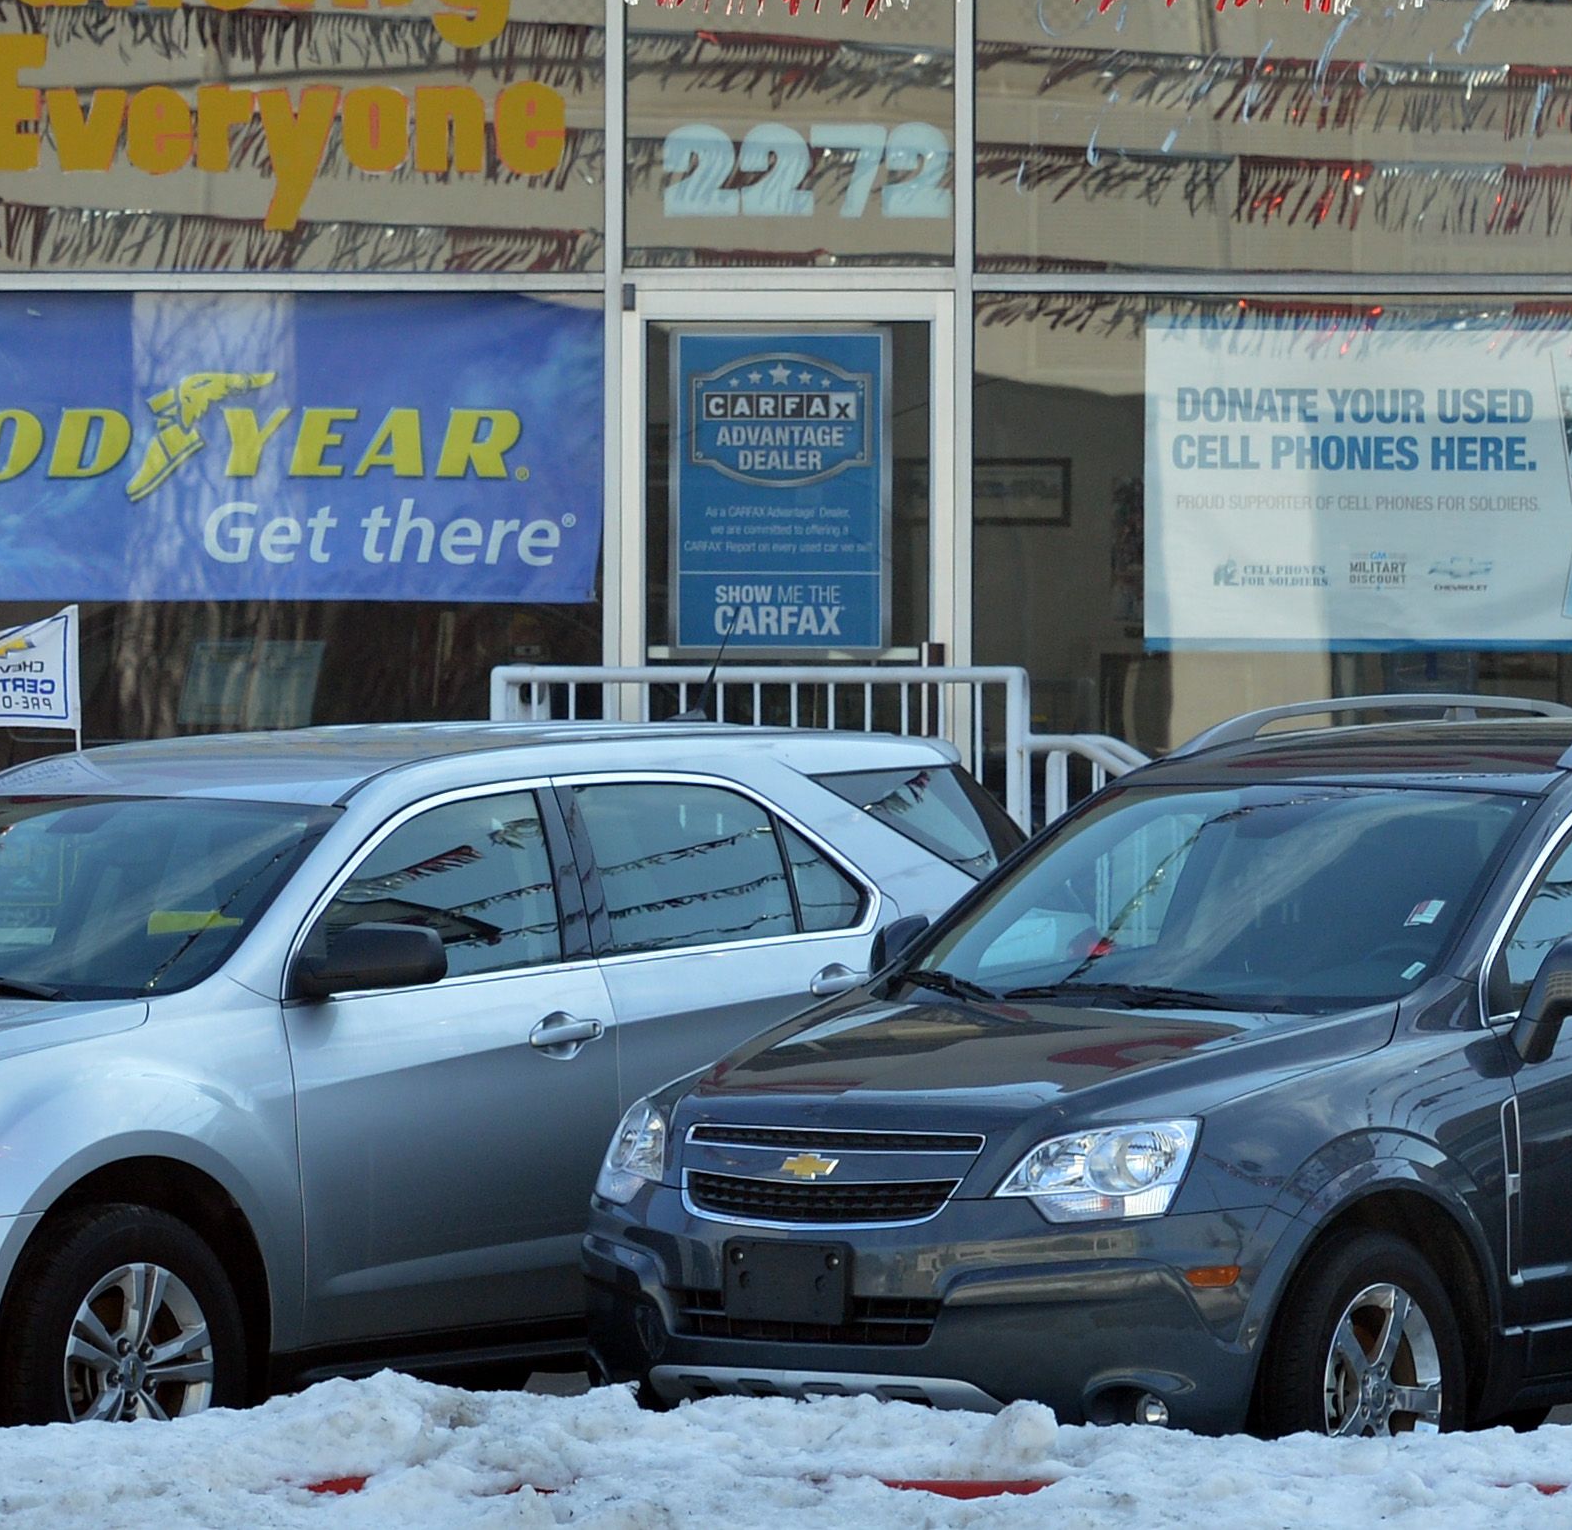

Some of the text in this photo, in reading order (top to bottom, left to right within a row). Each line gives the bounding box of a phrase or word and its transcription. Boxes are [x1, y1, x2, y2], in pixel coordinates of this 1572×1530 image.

[663, 121, 954, 219] 2272
[707, 394, 852, 419] CARFAX
[1176, 386, 1533, 424] DONATE YOUR USED
[716, 426, 845, 447] ADVANTAGE
[738, 450, 822, 471] DEALER
[1172, 434, 1537, 472] CELL PHONES HERE.
[1176, 495, 1540, 512] PROUD SUPPORTER OF CELL PHONES FOR SOLDIERS.
[203, 501, 335, 566] Get
[1244, 565, 1326, 575] CELL PHONES
[1349, 562, 1407, 574] MILITARY
[1241, 577, 1265, 587] FOR
[1349, 574, 1407, 584] DISCOUNT
[715, 585, 841, 604] SHOW ME THE
[714, 605, 842, 637] CARFAX
